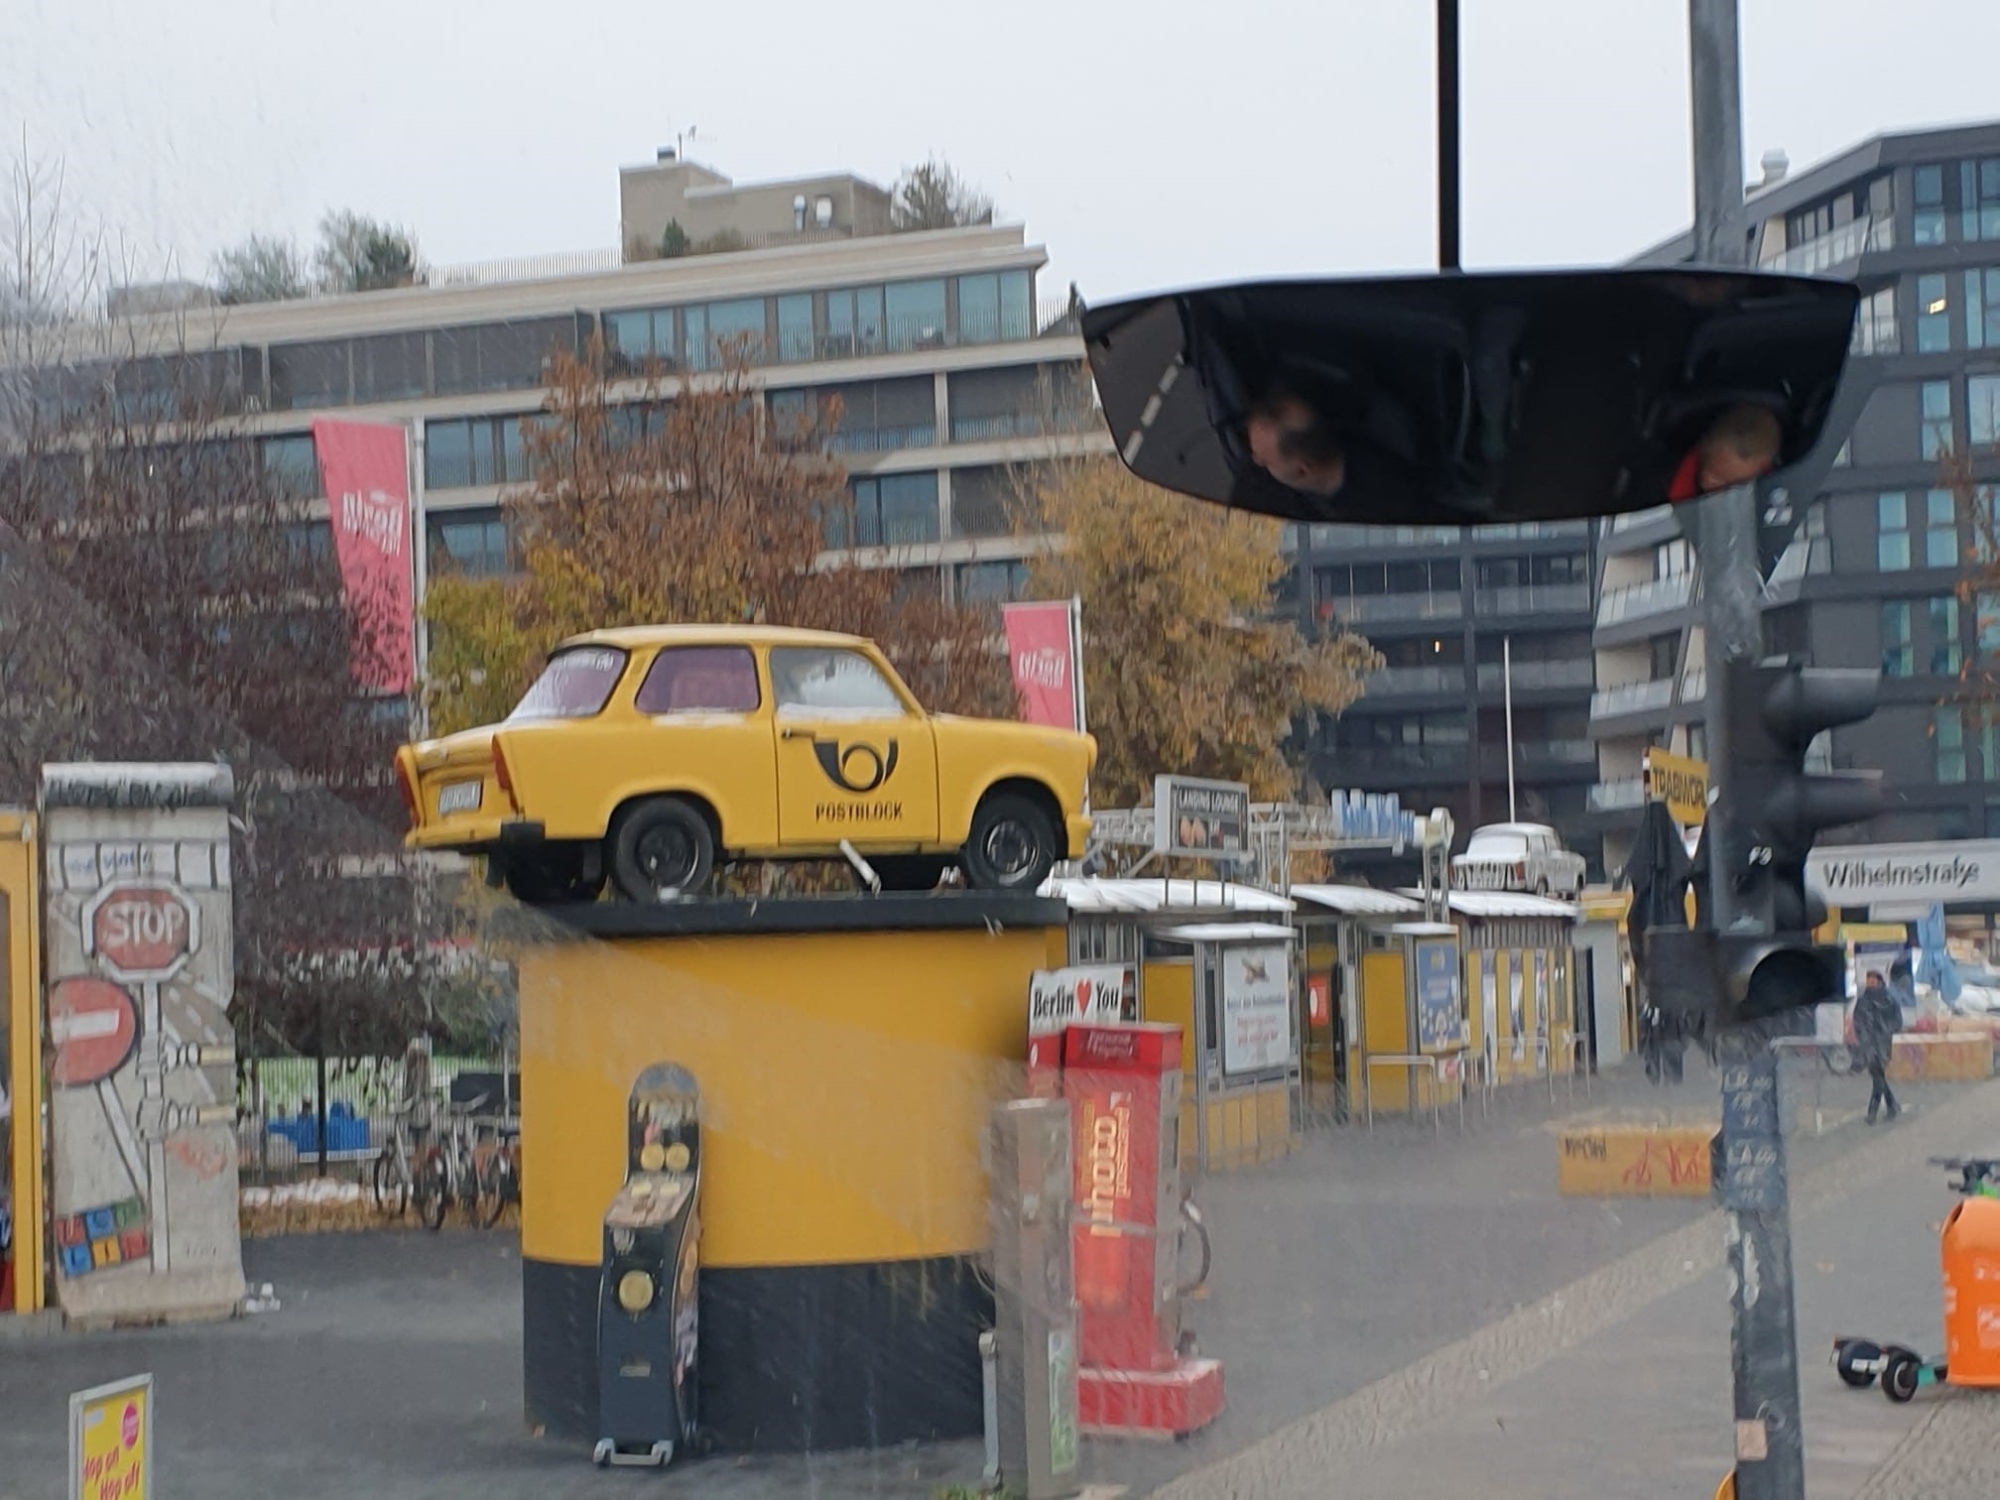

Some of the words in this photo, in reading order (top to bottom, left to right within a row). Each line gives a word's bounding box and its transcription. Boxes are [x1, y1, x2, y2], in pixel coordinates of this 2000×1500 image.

[815, 801, 903, 823] POSTBLOCK
[1823, 855, 1980, 889] Wilhelmstraße
[104, 901, 185, 948] STOP
[1033, 985, 1075, 1020] Berlin
[1096, 980, 1119, 1011] You
